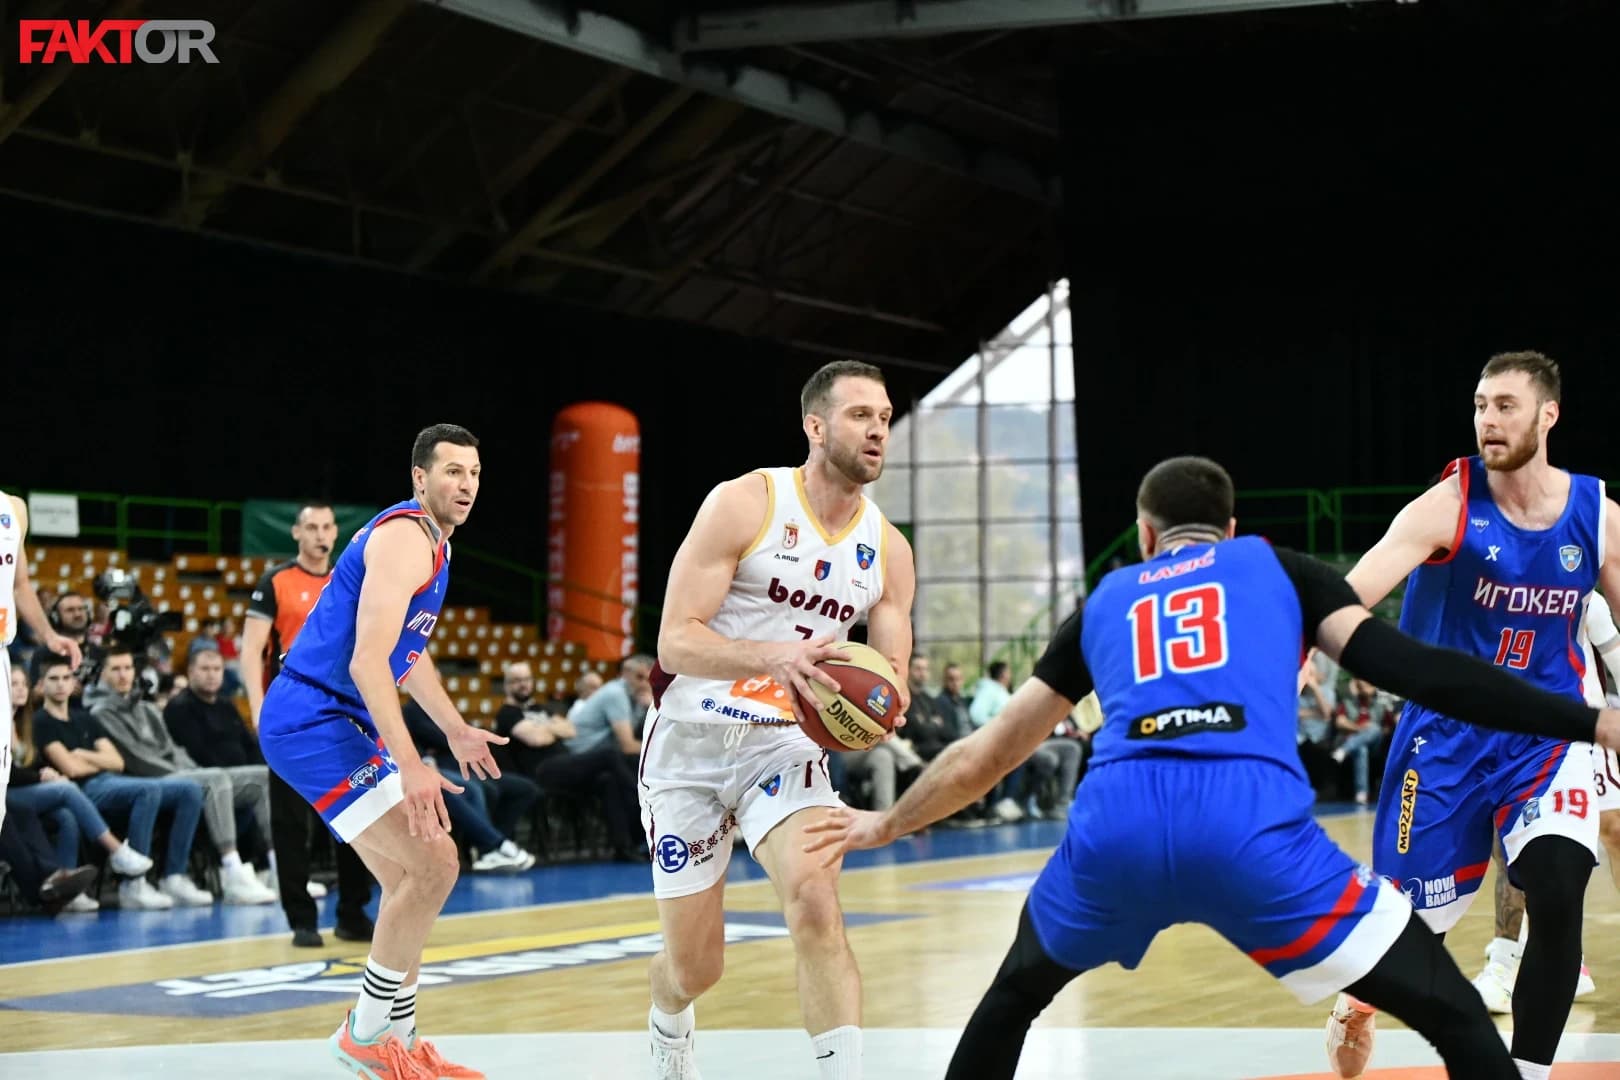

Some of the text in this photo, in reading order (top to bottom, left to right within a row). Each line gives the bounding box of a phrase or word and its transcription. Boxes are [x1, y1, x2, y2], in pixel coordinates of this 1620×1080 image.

[407, 610, 438, 637] ИГО
[1126, 582, 1229, 684] 13
[1494, 627, 1535, 669] 19
[826, 699, 881, 745] PALDING
[1141, 705, 1232, 735] OPTIMA
[1399, 773, 1417, 850] MOZZART
[1552, 788, 1589, 820] 19
[1424, 874, 1456, 895] NOVA
